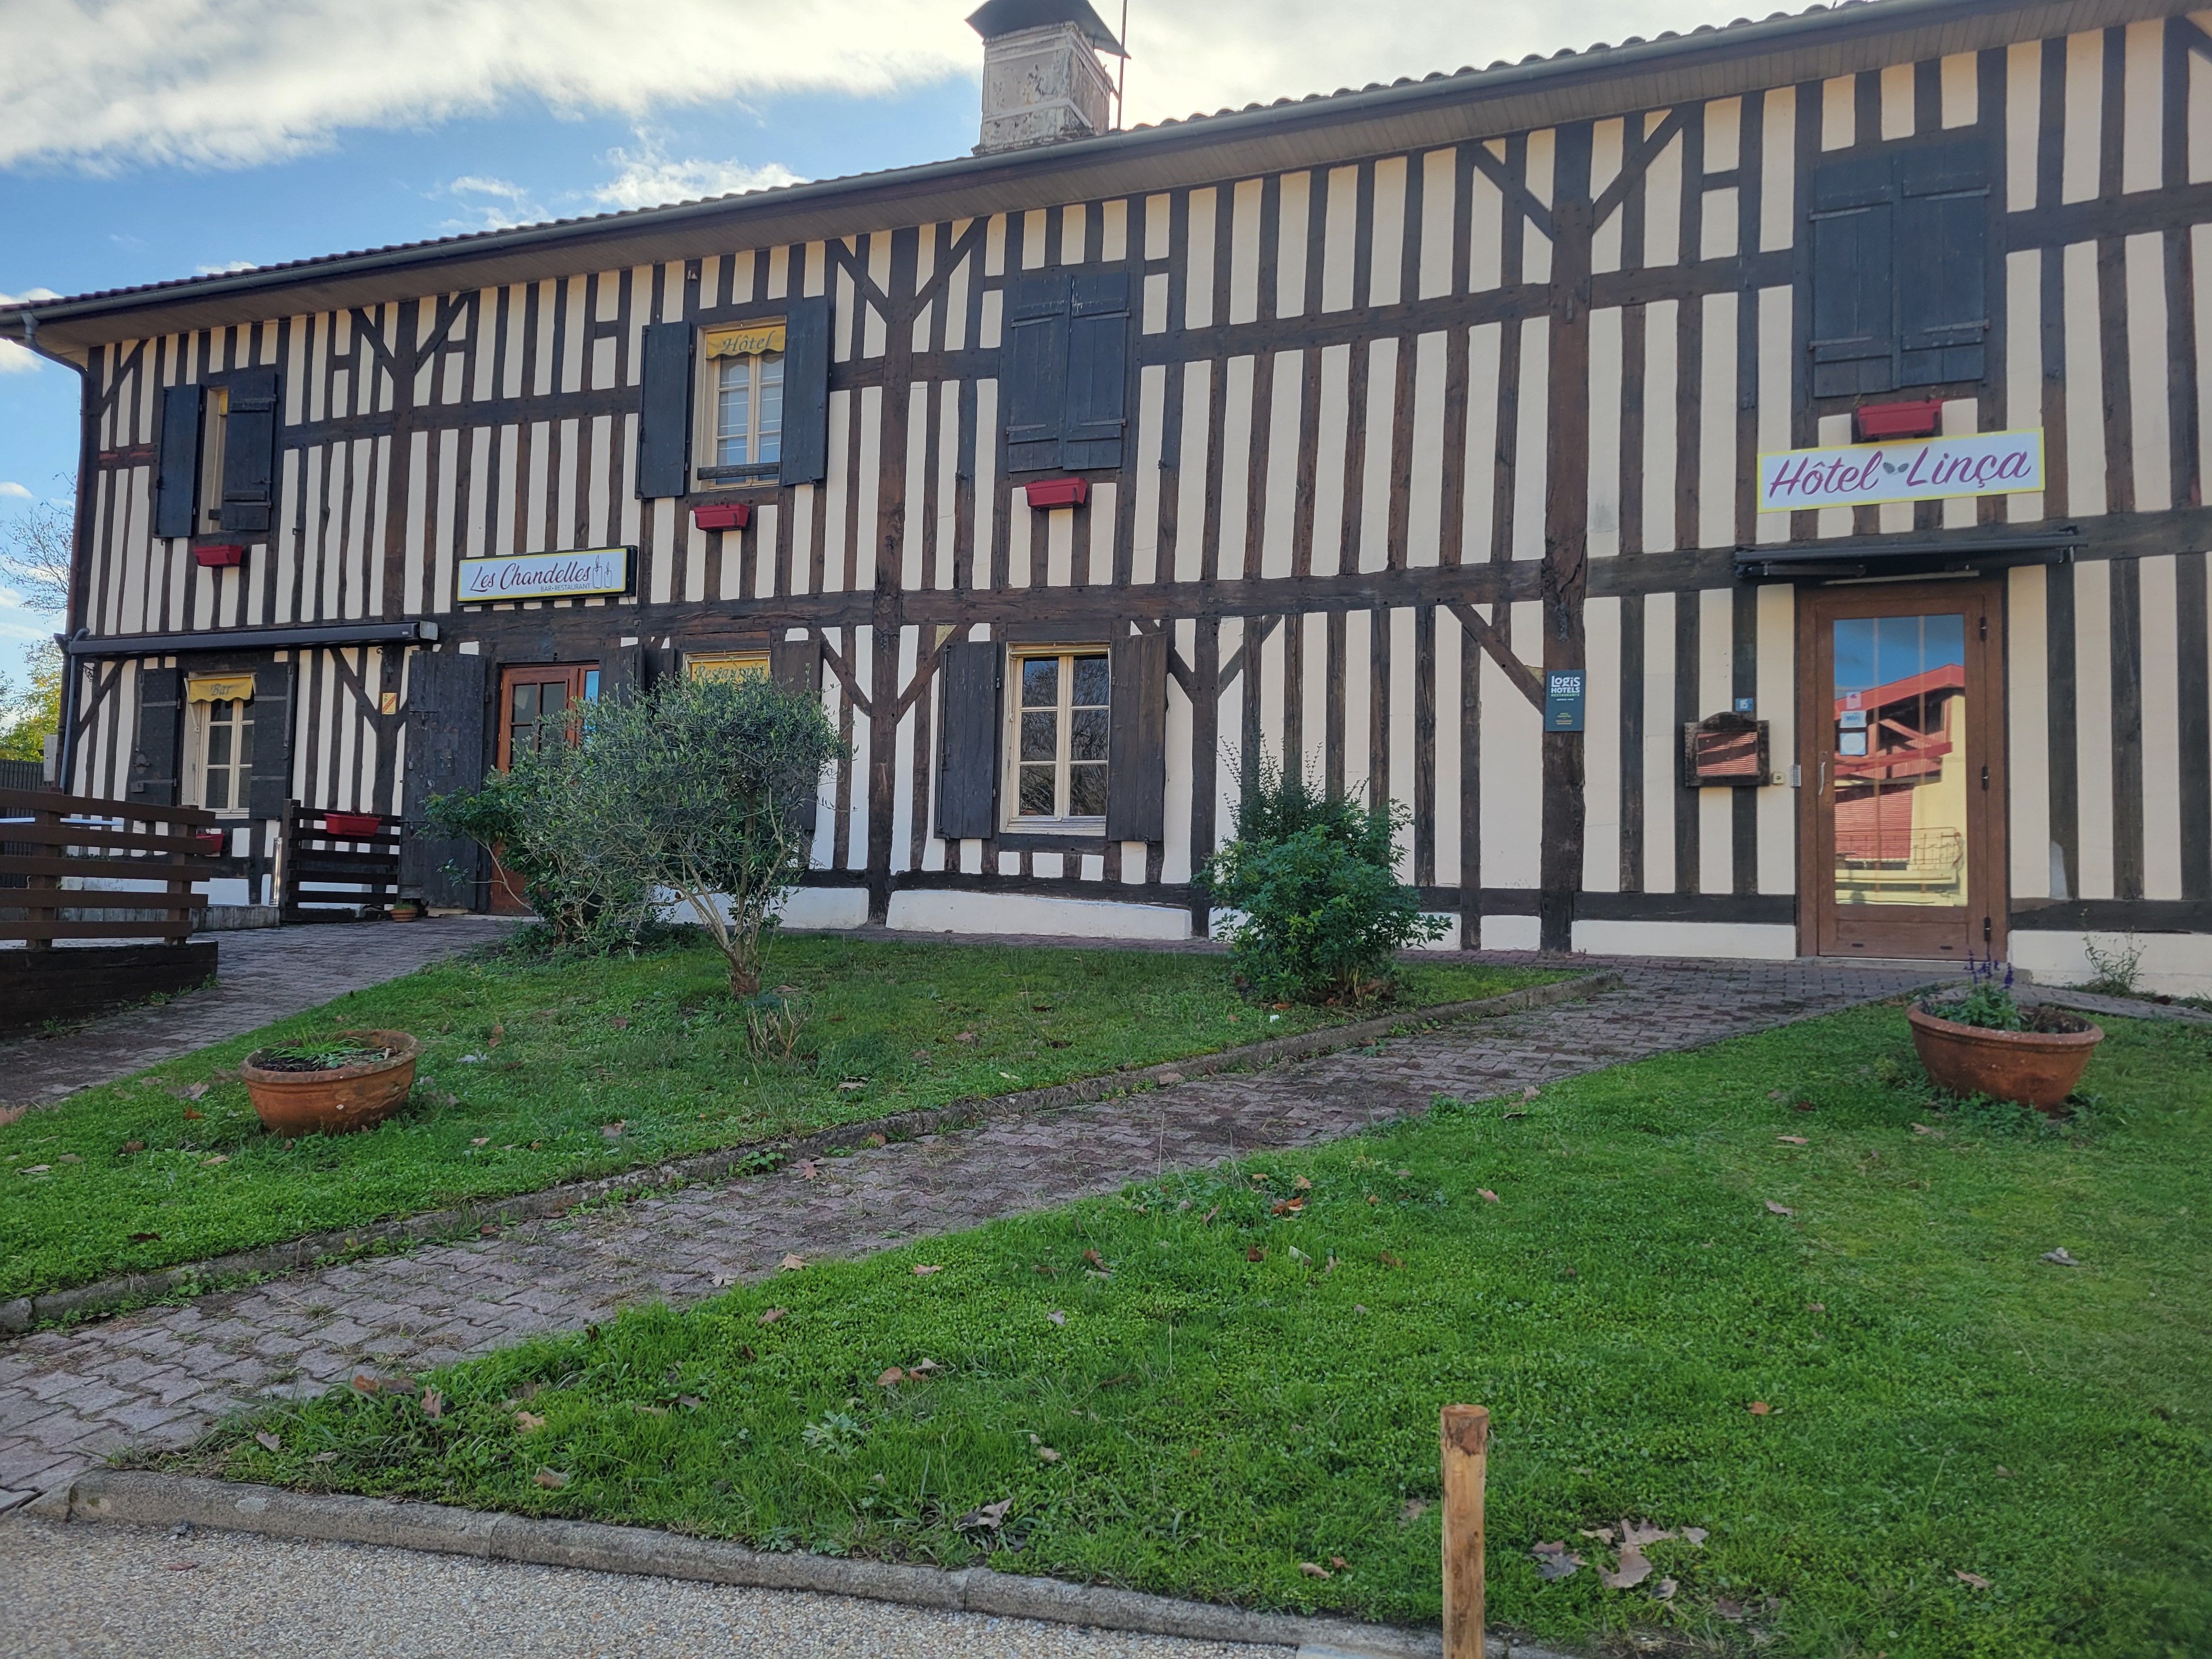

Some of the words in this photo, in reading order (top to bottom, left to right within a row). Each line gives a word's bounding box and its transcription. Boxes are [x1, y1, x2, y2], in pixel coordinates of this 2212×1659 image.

[721, 330, 776, 352] Hôtel
[1769, 450, 1883, 498] Hôtel
[1906, 446, 2032, 489] Linça
[470, 566, 495, 592] Les
[500, 562, 591, 590] Chandelles
[694, 665, 766, 681] Resaurant
[1551, 675, 1581, 687] Logis
[211, 684, 234, 696] Bar
[1740, 700, 1748, 709] 15
